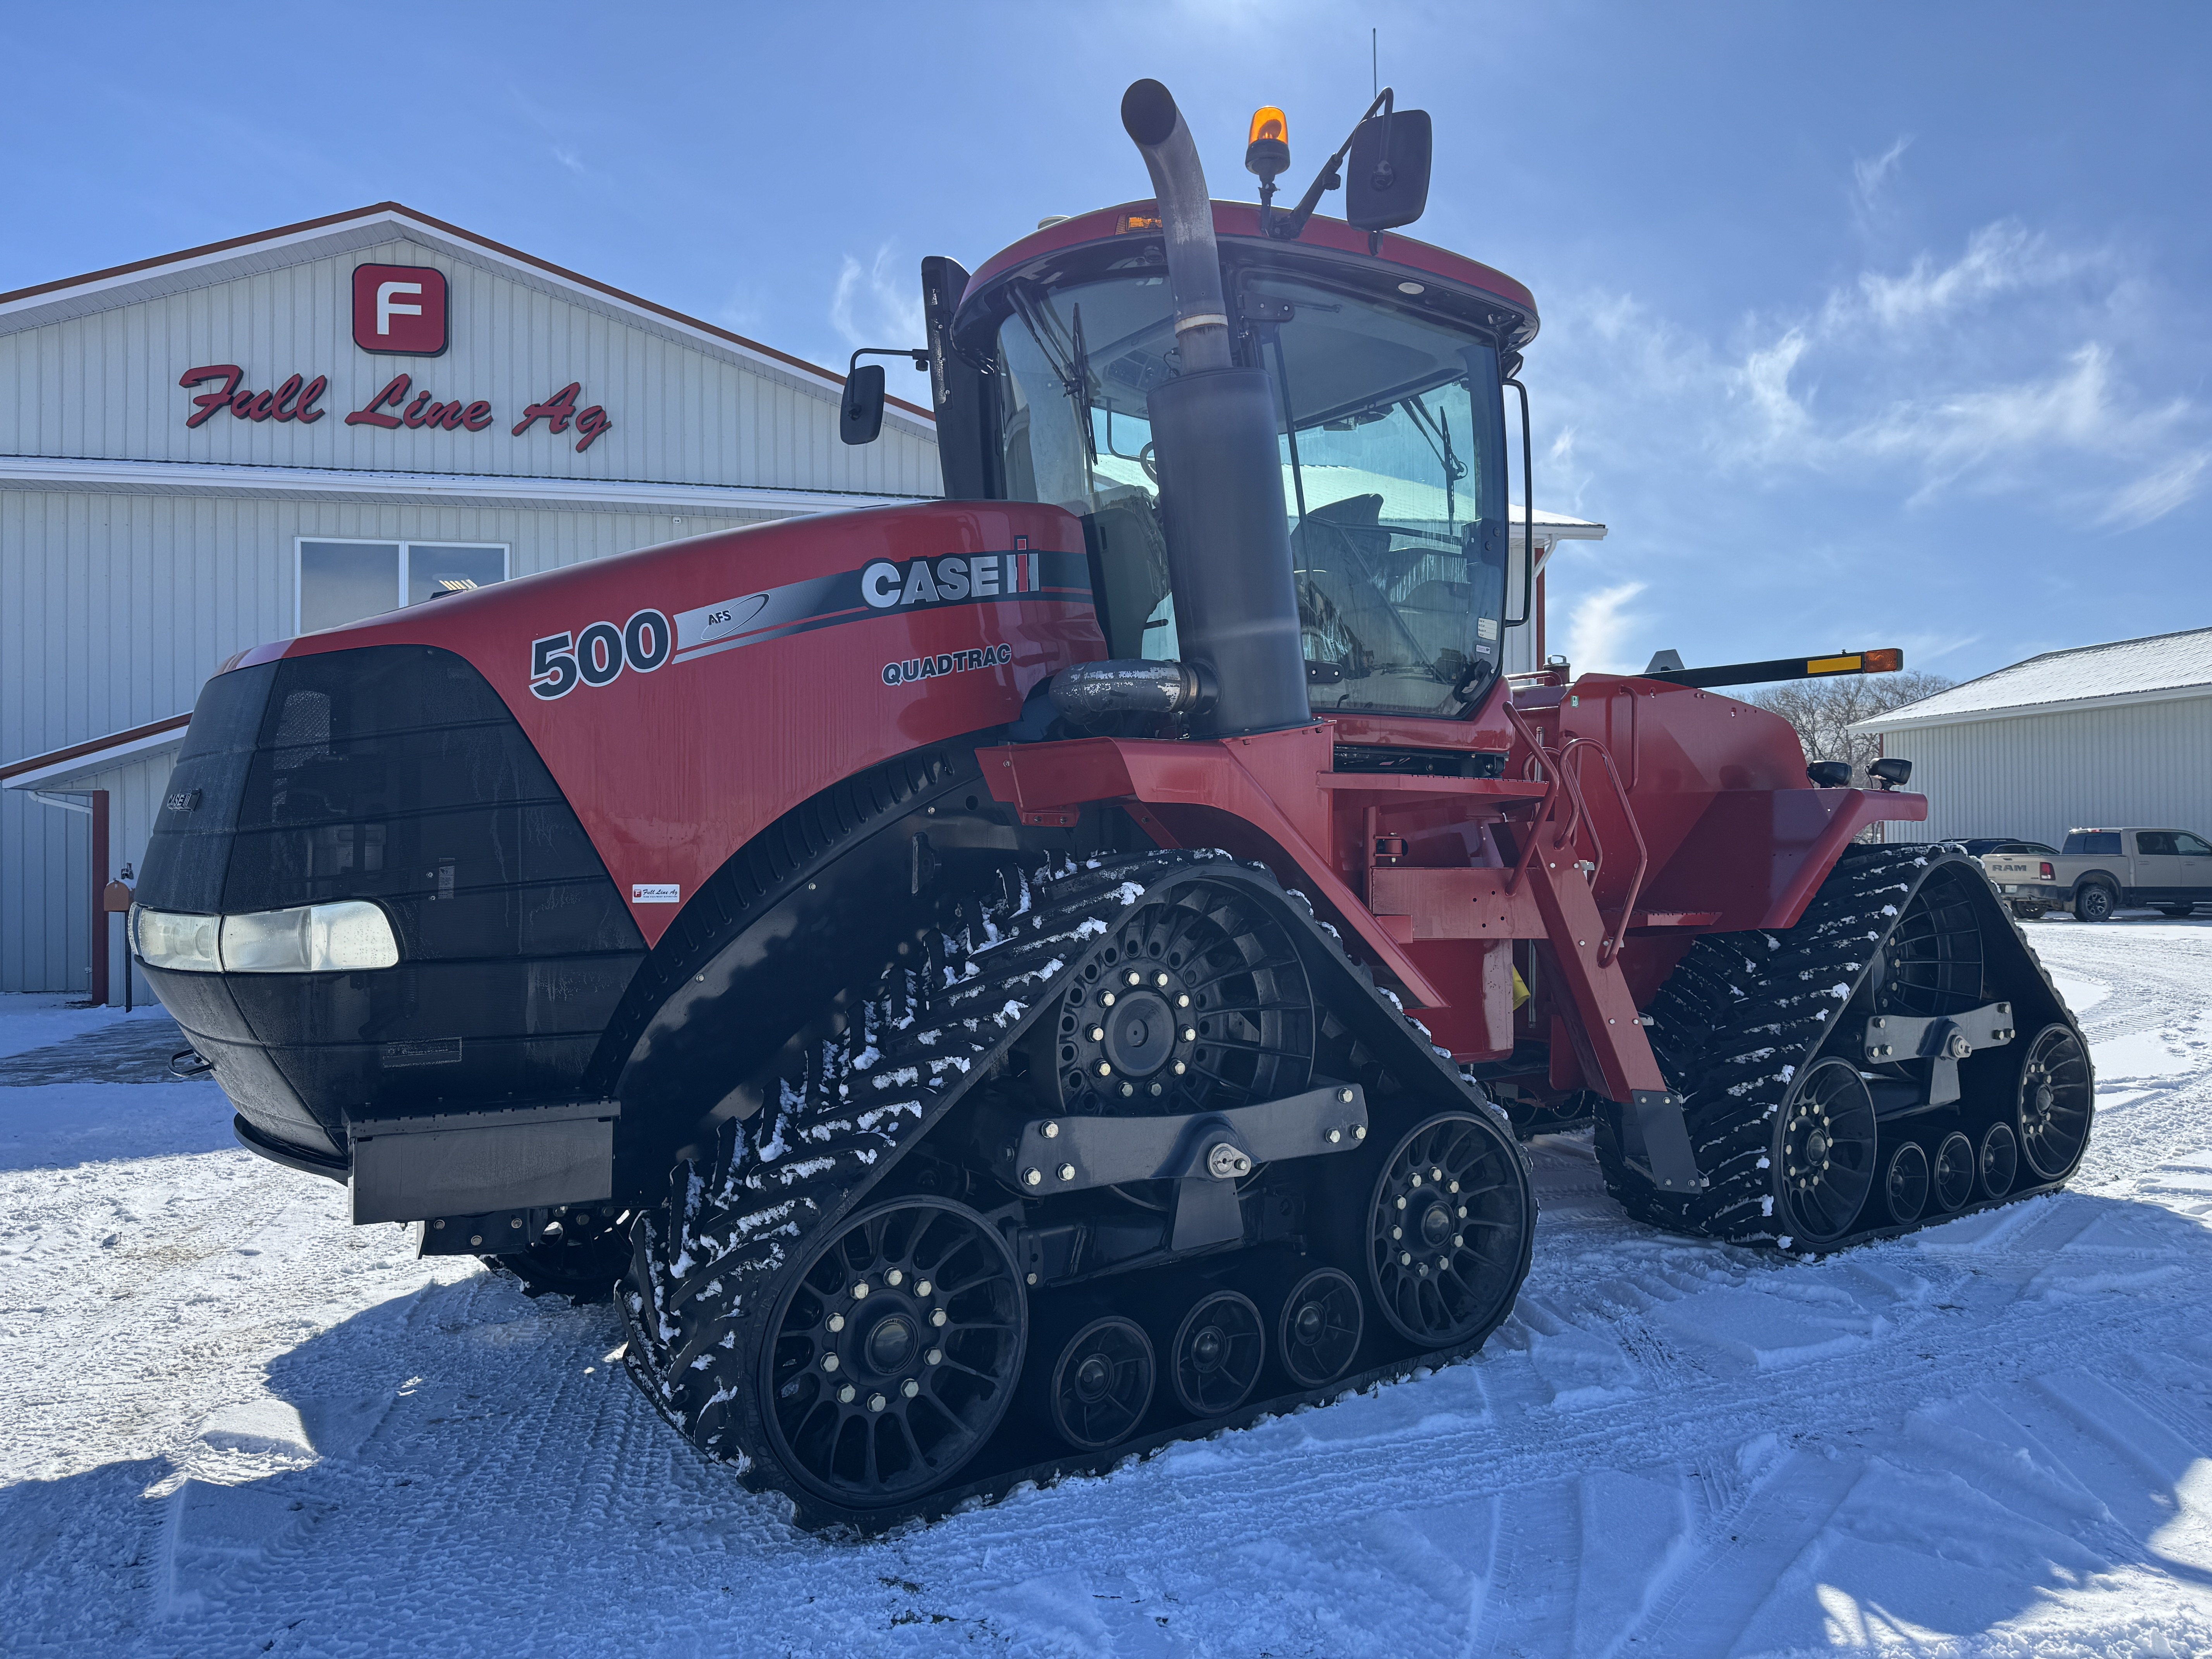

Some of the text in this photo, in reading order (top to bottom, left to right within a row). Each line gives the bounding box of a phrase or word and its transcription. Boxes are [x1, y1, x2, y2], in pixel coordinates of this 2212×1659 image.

[377, 281, 422, 335] F
[179, 364, 612, 453] Full Line Ag
[709, 610, 732, 626] AFS
[529, 608, 672, 701] 500
[882, 643, 1012, 686] QUADTRAC
